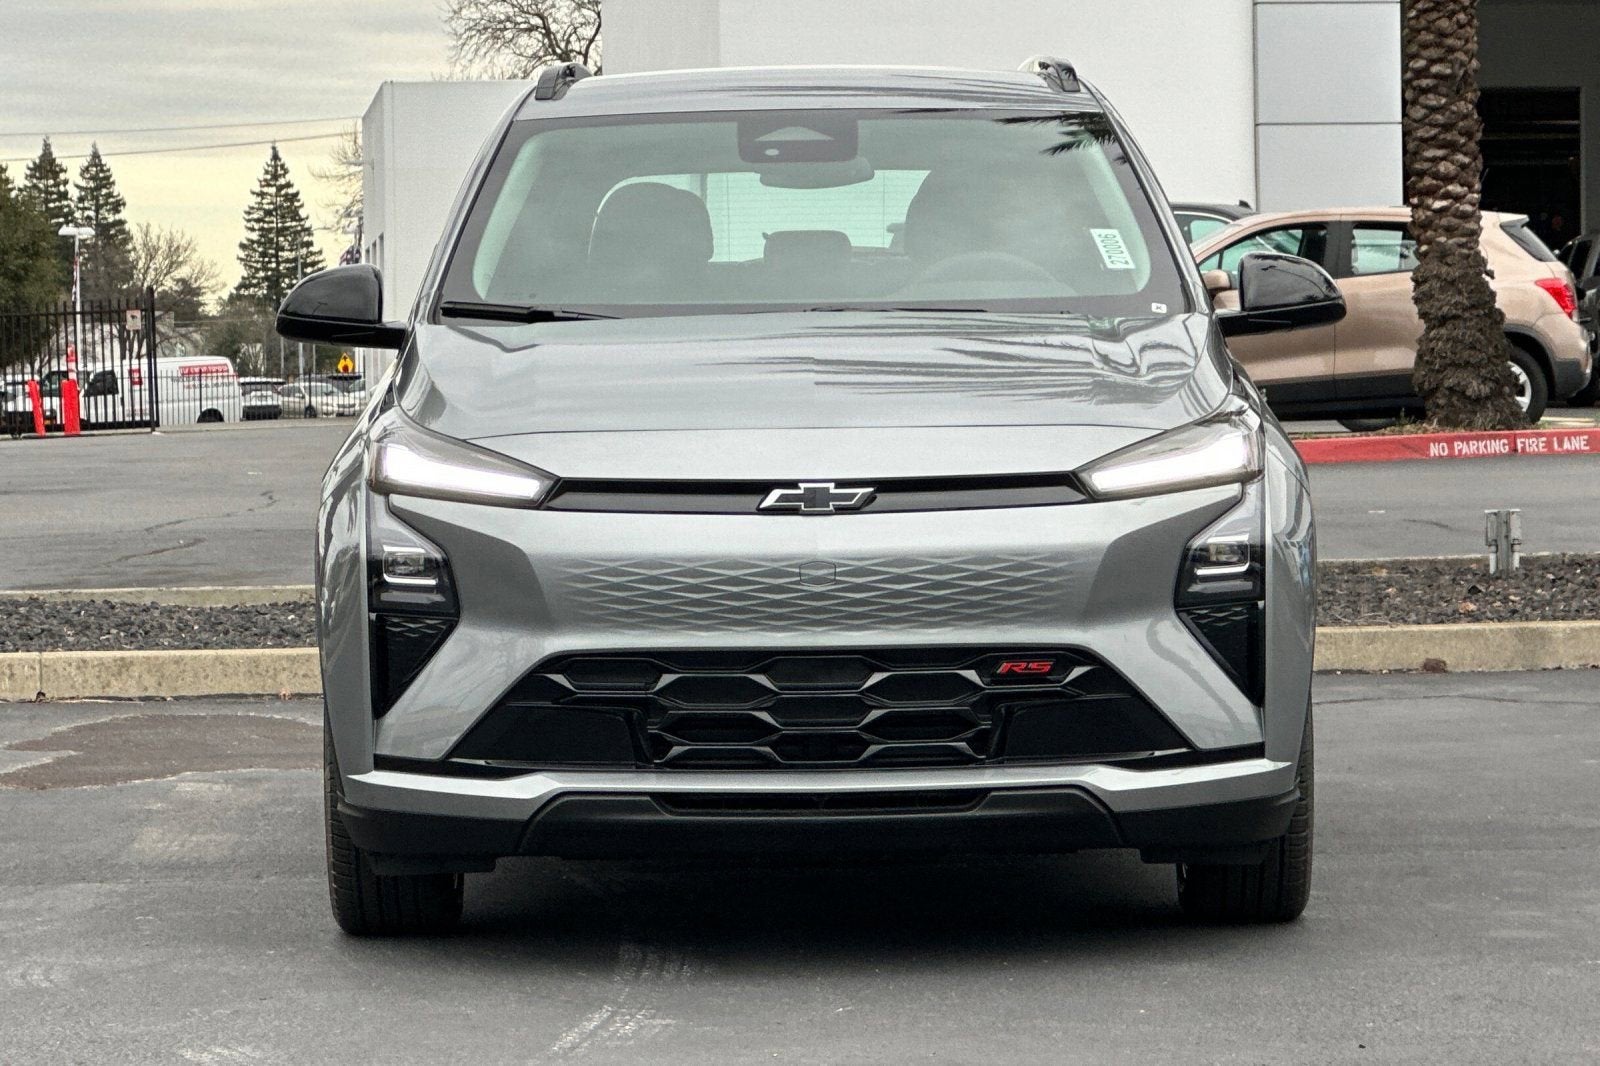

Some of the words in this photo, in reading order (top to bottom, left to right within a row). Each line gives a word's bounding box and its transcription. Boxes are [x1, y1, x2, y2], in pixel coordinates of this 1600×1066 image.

[1098, 233, 1130, 265] 270006
[1429, 442, 1449, 457] NO
[1454, 438, 1509, 456] PARKING
[1516, 437, 1547, 453] FIRE
[1553, 435, 1590, 451] LANE
[996, 661, 1054, 673] RS
